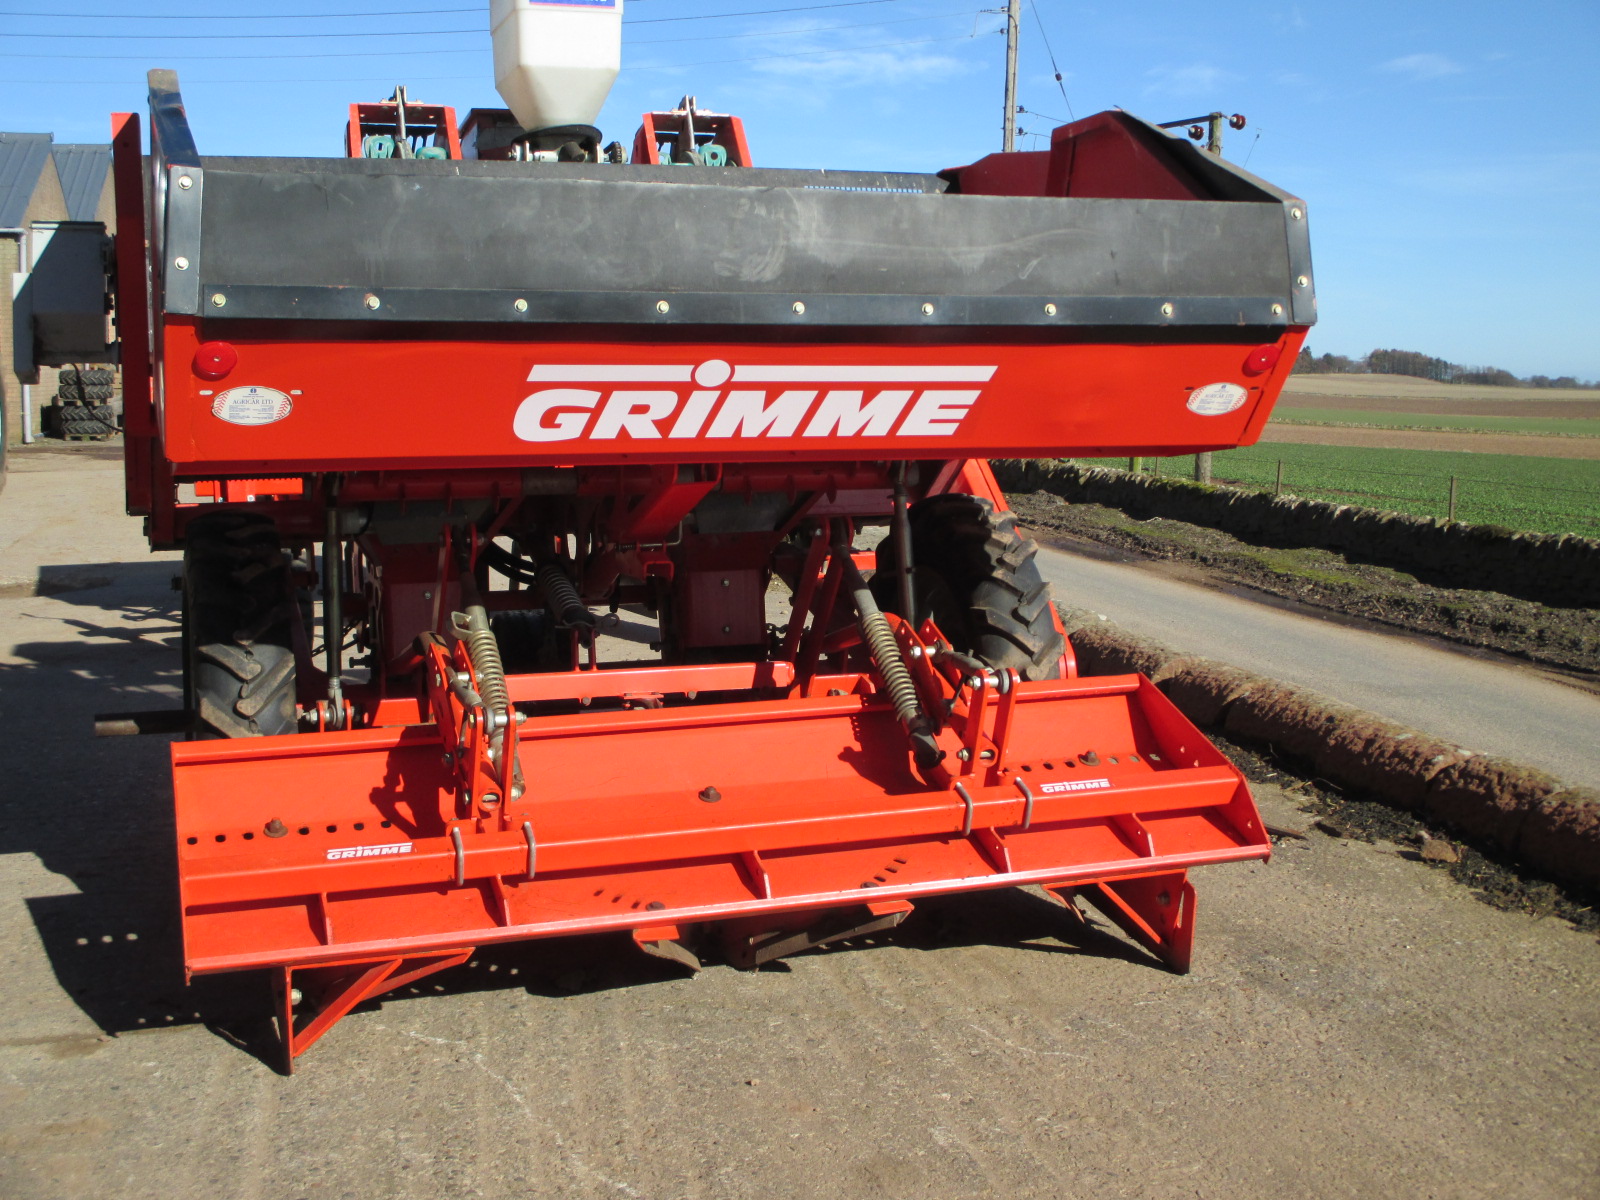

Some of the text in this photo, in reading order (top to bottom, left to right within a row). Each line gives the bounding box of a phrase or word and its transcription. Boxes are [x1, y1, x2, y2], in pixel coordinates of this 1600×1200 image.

[513, 359, 990, 442] GRIMME
[1040, 778, 1111, 793] GRIMME
[326, 842, 412, 860] GRIMME
